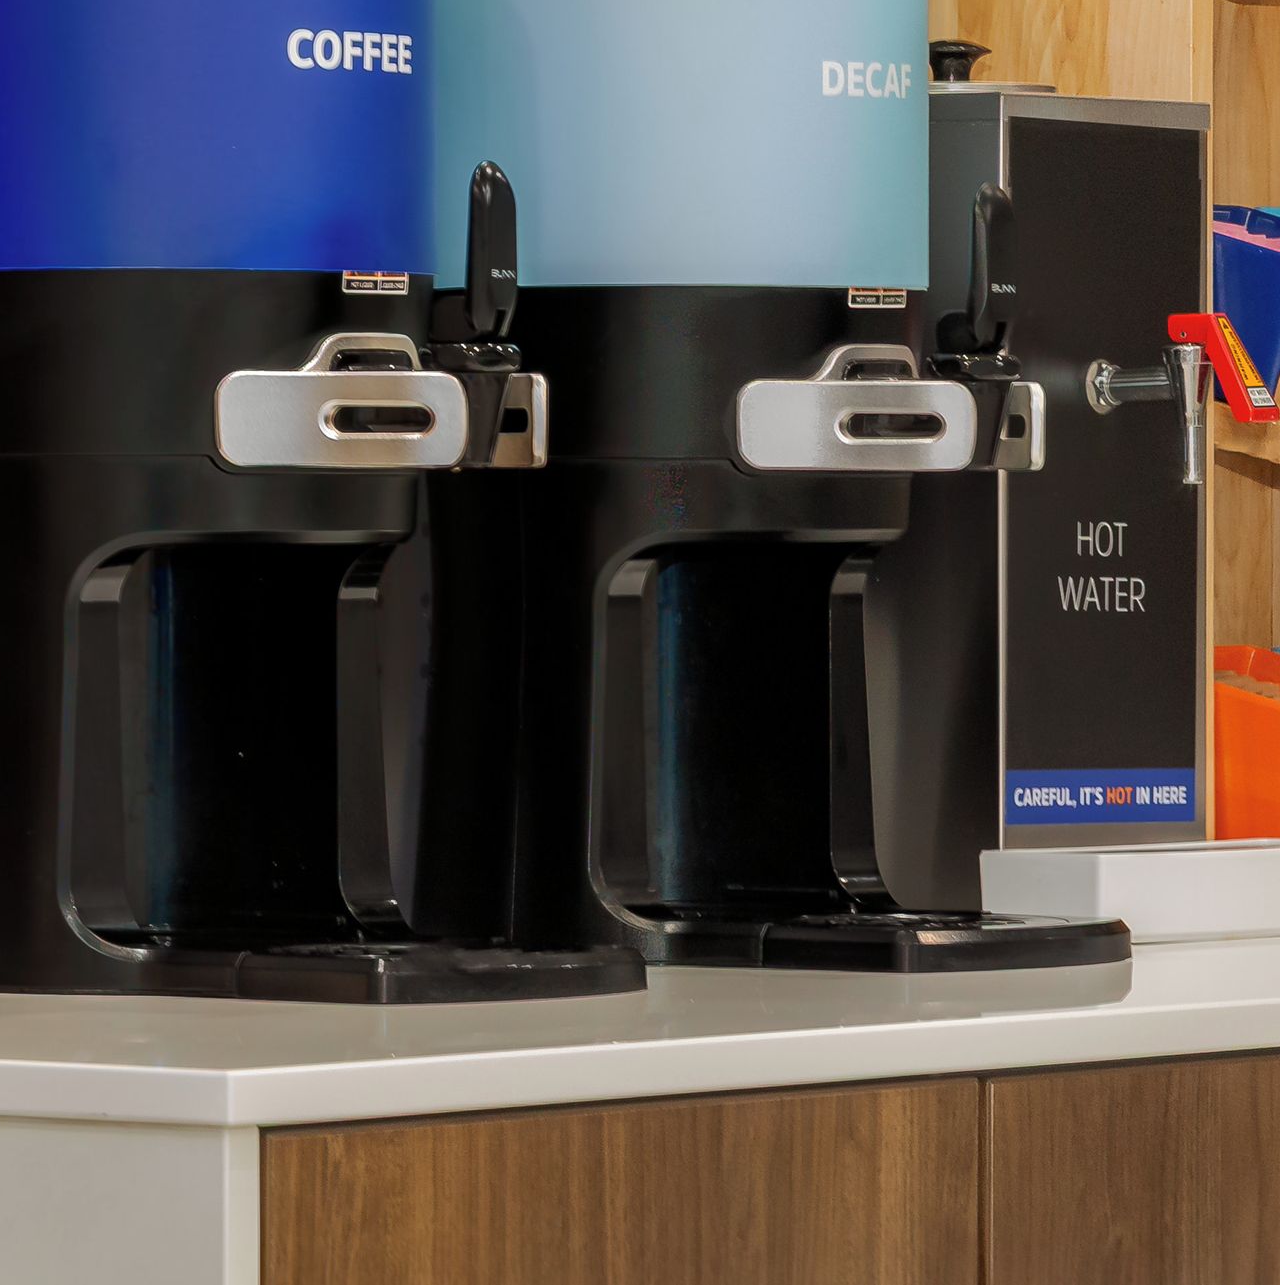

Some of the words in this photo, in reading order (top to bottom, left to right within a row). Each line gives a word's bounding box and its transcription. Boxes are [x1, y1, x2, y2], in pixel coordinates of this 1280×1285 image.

[286, 28, 413, 75] COFFEE
[821, 60, 912, 99] DECAF
[1077, 521, 1128, 558] HOT
[1057, 575, 1147, 613] WATER
[1014, 786, 1077, 809] CAREFUL,
[1079, 786, 1104, 806] IT'S
[1106, 785, 1133, 806] HOT
[1135, 786, 1151, 806] IN
[1152, 785, 1188, 806] HERE
